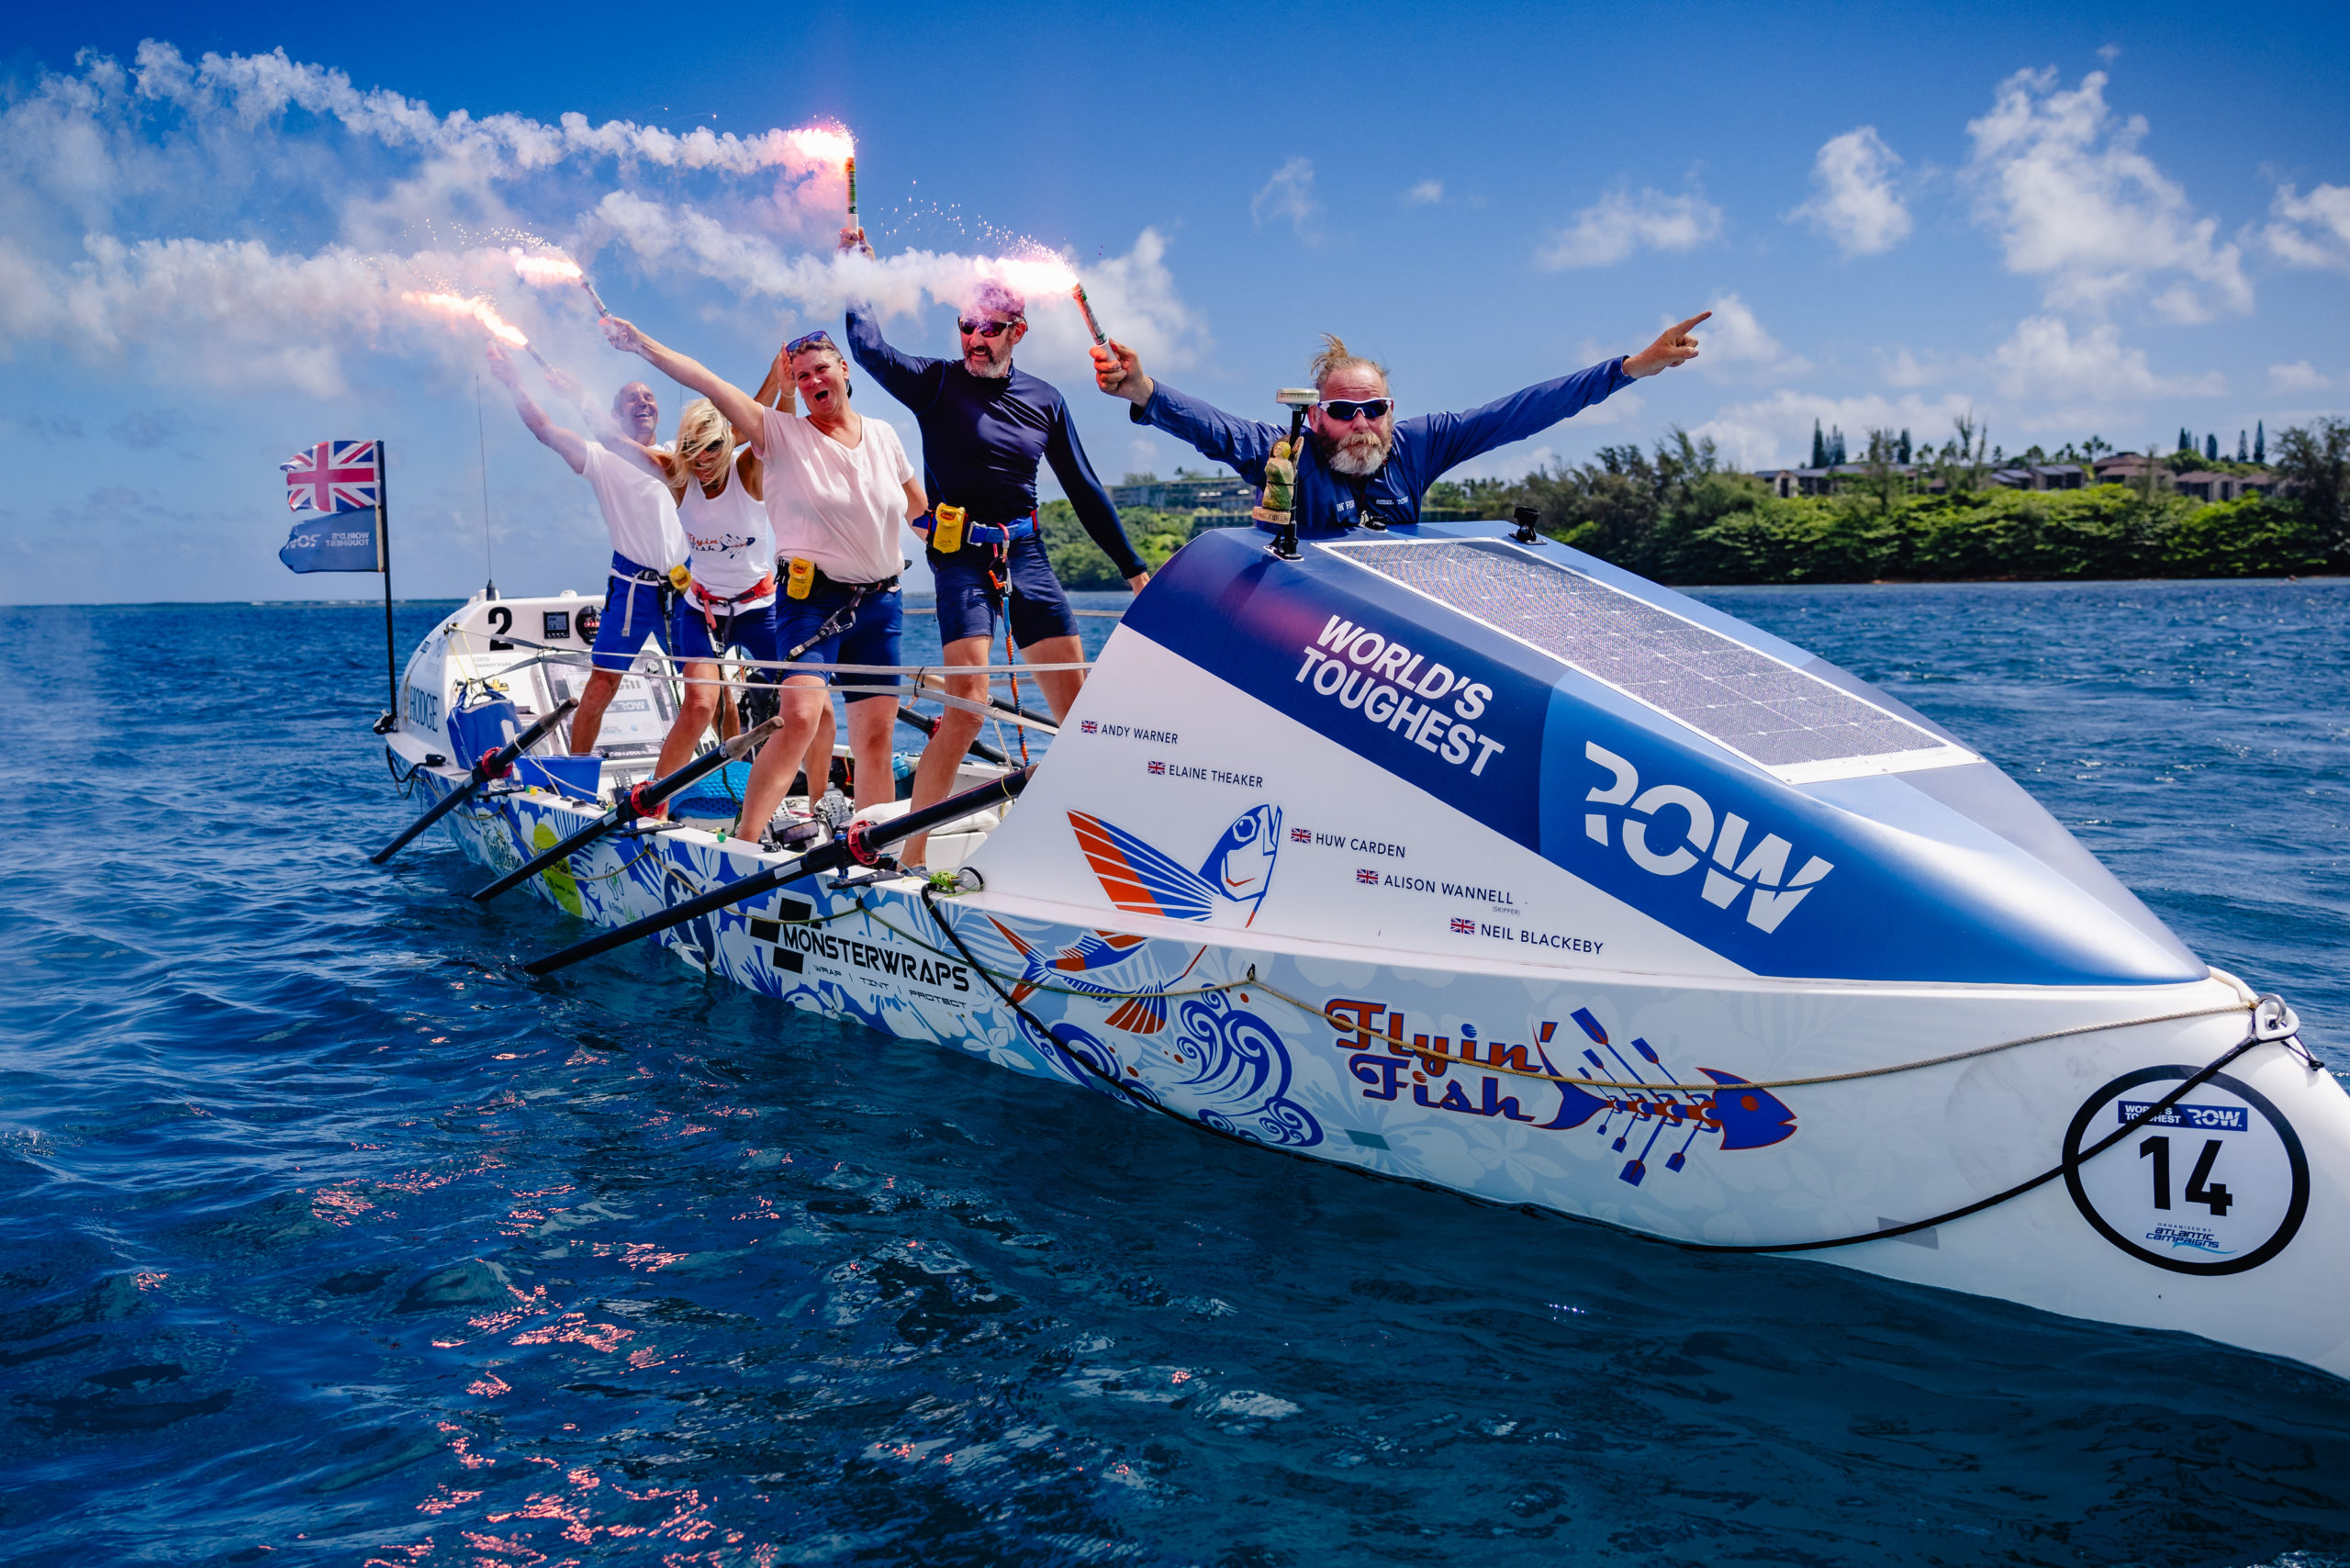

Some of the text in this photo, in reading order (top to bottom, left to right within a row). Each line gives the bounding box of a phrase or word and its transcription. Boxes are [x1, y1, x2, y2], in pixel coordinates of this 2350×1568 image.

[488, 606, 514, 652] 2
[1315, 614, 1494, 722] WORLD'S
[409, 687, 438, 733] HODGE
[1294, 645, 1505, 778] TOUGHEST
[1101, 723, 1178, 745] ANDY WARNER
[1169, 765, 1263, 789] ELAINE THEAKER
[1315, 833, 1406, 858] HUW CARDEN
[1584, 740, 1834, 935] ROW
[1384, 874, 1515, 905] ALISON WANNELL
[1493, 906, 1520, 916] (SKIPPER)
[782, 924, 970, 992] MONSTERWRAPS
[1481, 924, 1605, 956] NEIL BLACKEBY
[813, 964, 967, 1010] WRAP TINT PROTECT
[1324, 998, 1559, 1078] Flyin'
[1348, 1053, 1536, 1124] Fish
[2125, 1113, 2181, 1124] TOHEST
[2187, 1108, 2241, 1127] ROW
[2139, 1135, 2233, 1217] 14
[2157, 1222, 2200, 1232] ORGANIZED
